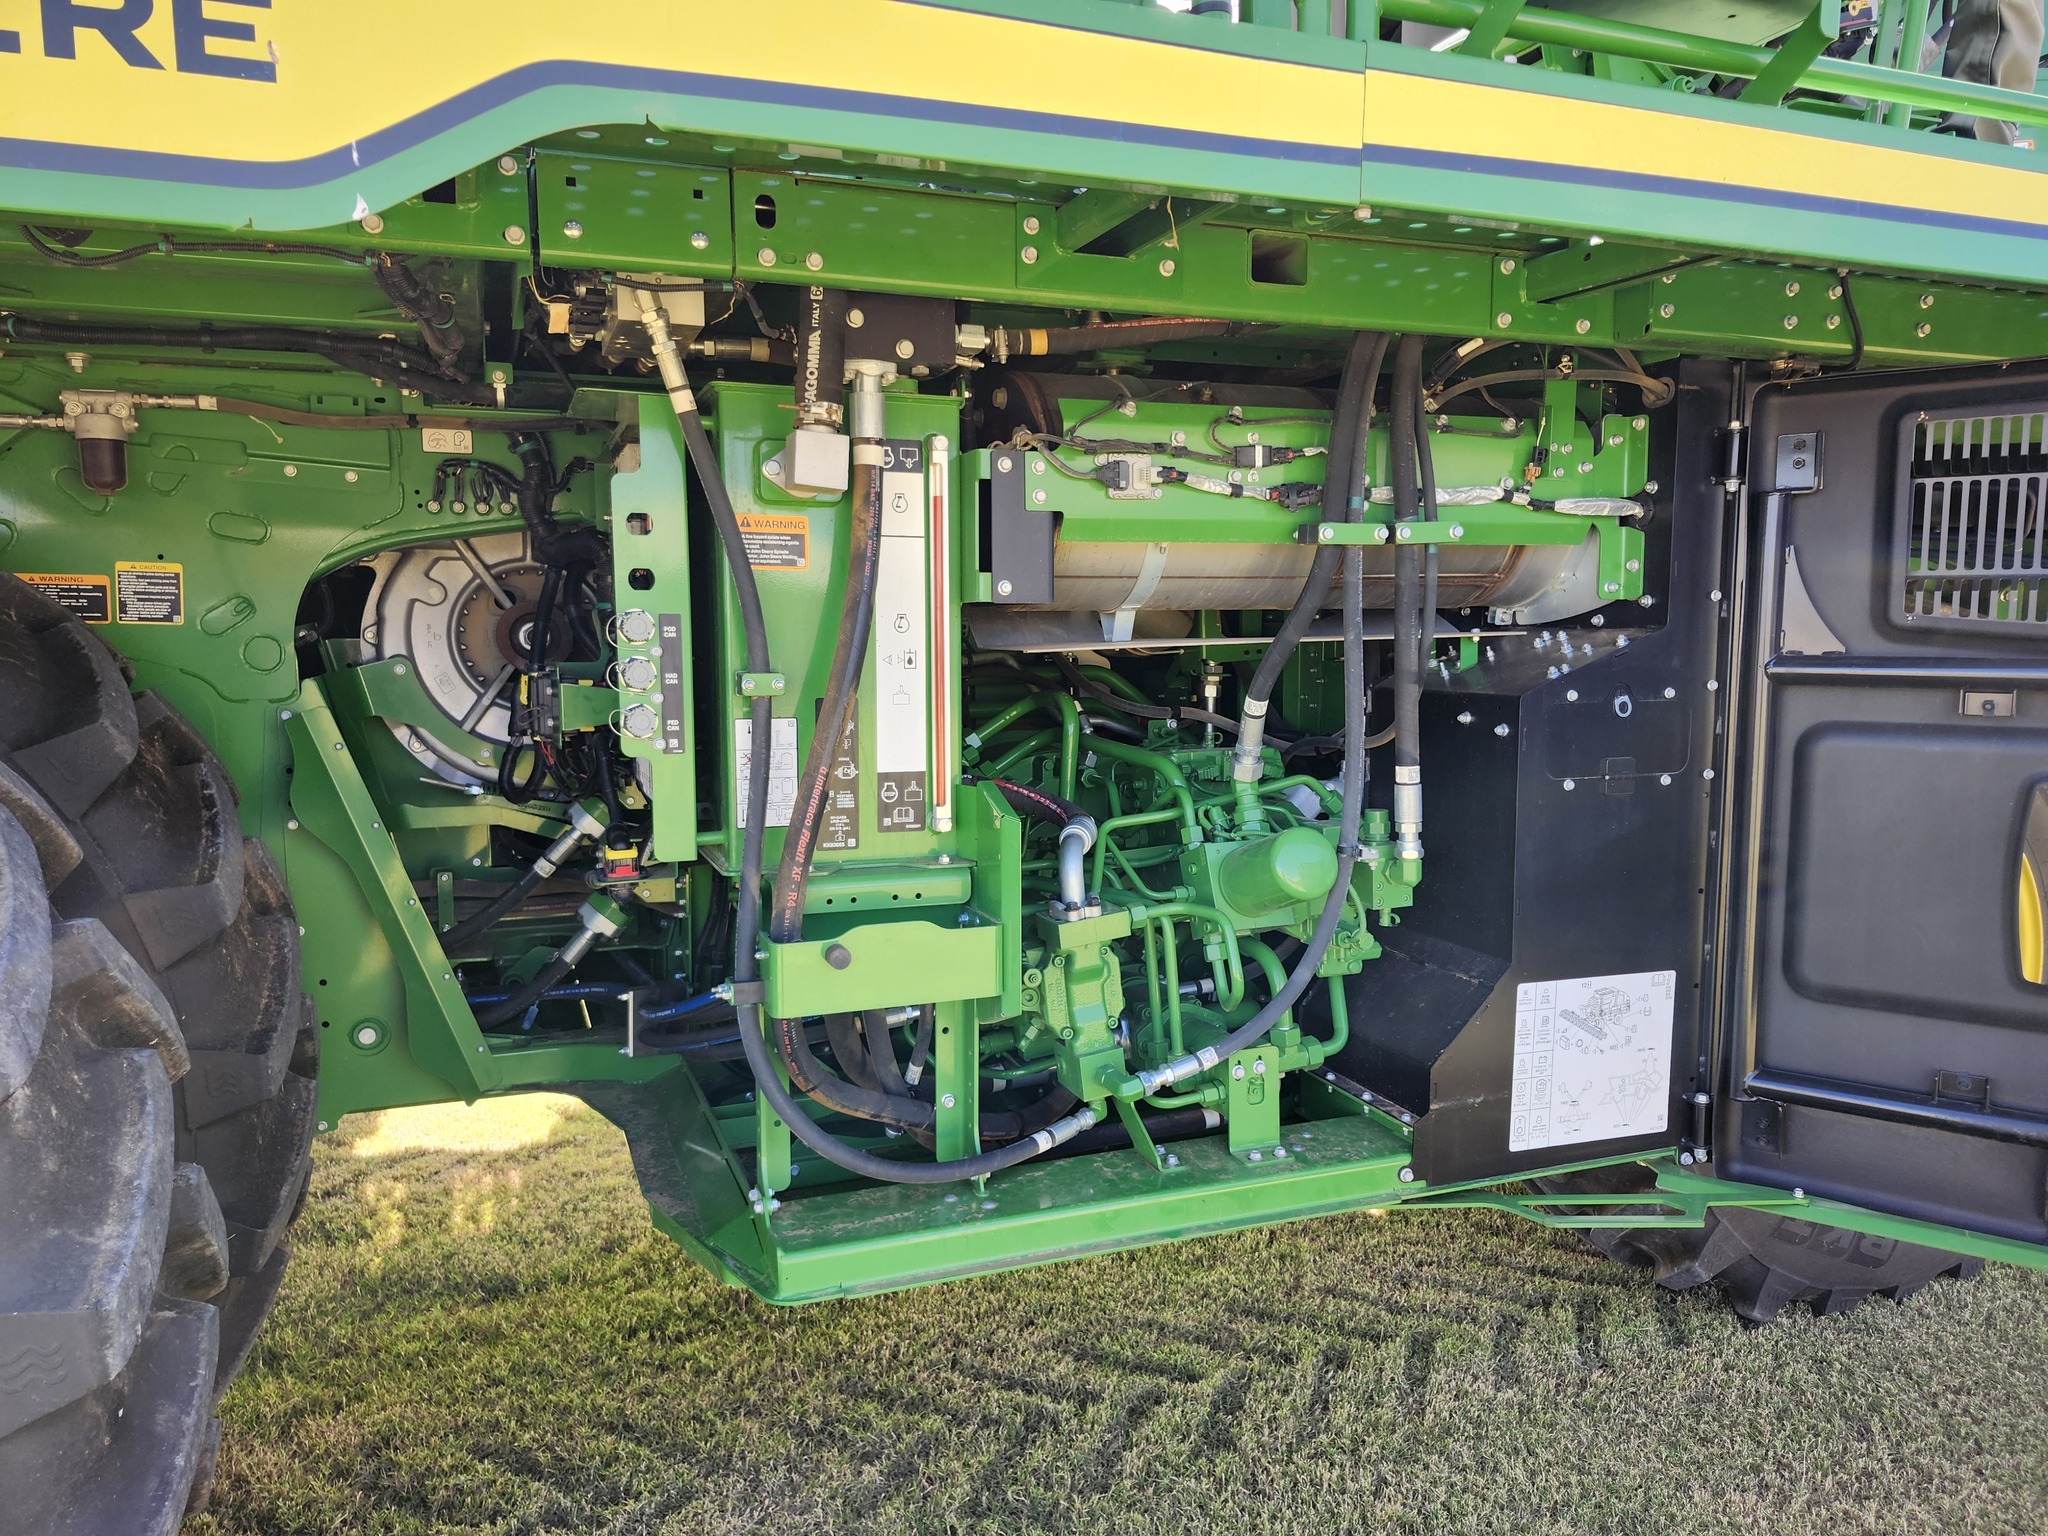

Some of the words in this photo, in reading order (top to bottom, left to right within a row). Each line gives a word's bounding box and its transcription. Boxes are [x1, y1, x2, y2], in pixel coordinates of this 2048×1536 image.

[0, 0, 277, 83] RE
[812, 302, 820, 327] ITALY
[804, 329, 821, 403] AGOMMA
[753, 519, 806, 530] WARNING
[39, 575, 84, 583] WARNING
[795, 829, 811, 863] Flexit
[792, 866, 803, 882] XF
[787, 891, 798, 908] R4
